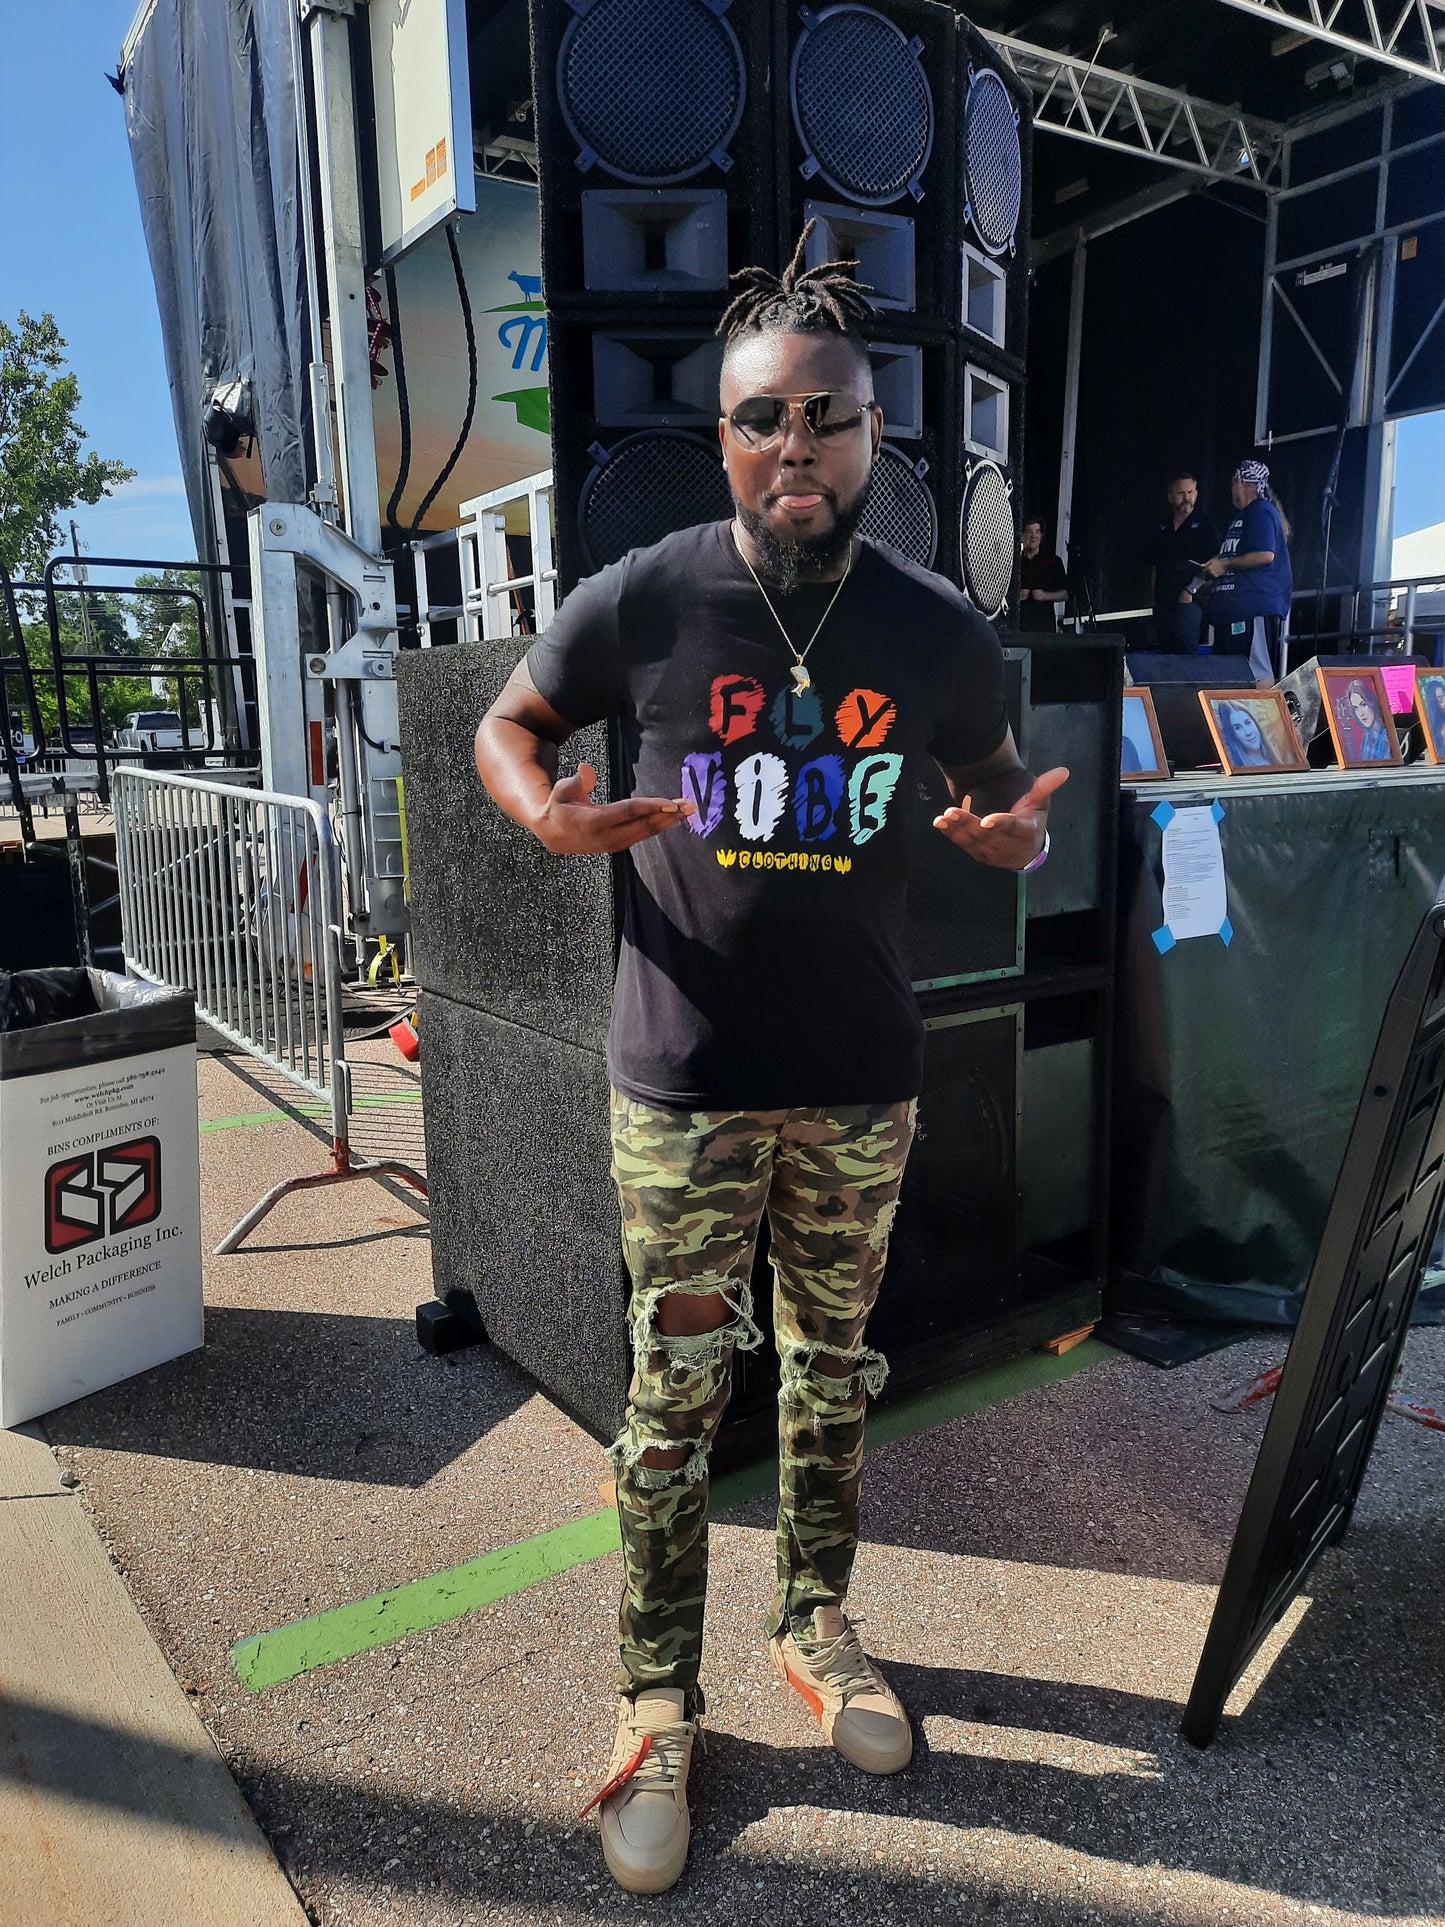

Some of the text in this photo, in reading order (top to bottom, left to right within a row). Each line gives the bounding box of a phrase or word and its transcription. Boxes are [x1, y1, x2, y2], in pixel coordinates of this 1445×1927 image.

[709, 674, 897, 749] FLY
[738, 851, 835, 872] CLOTHING
[74, 1084, 134, 1103] www.welchpkg.com
[47, 1116, 160, 1156] BINS COMPLIMENTS OF:
[24, 1225, 183, 1289] Welch Packaging Inc.
[49, 1260, 162, 1310] MAKING A DIFFERENCE
[56, 1312, 80, 1327] FAMILY
[84, 1296, 123, 1316] COMMUNITY
